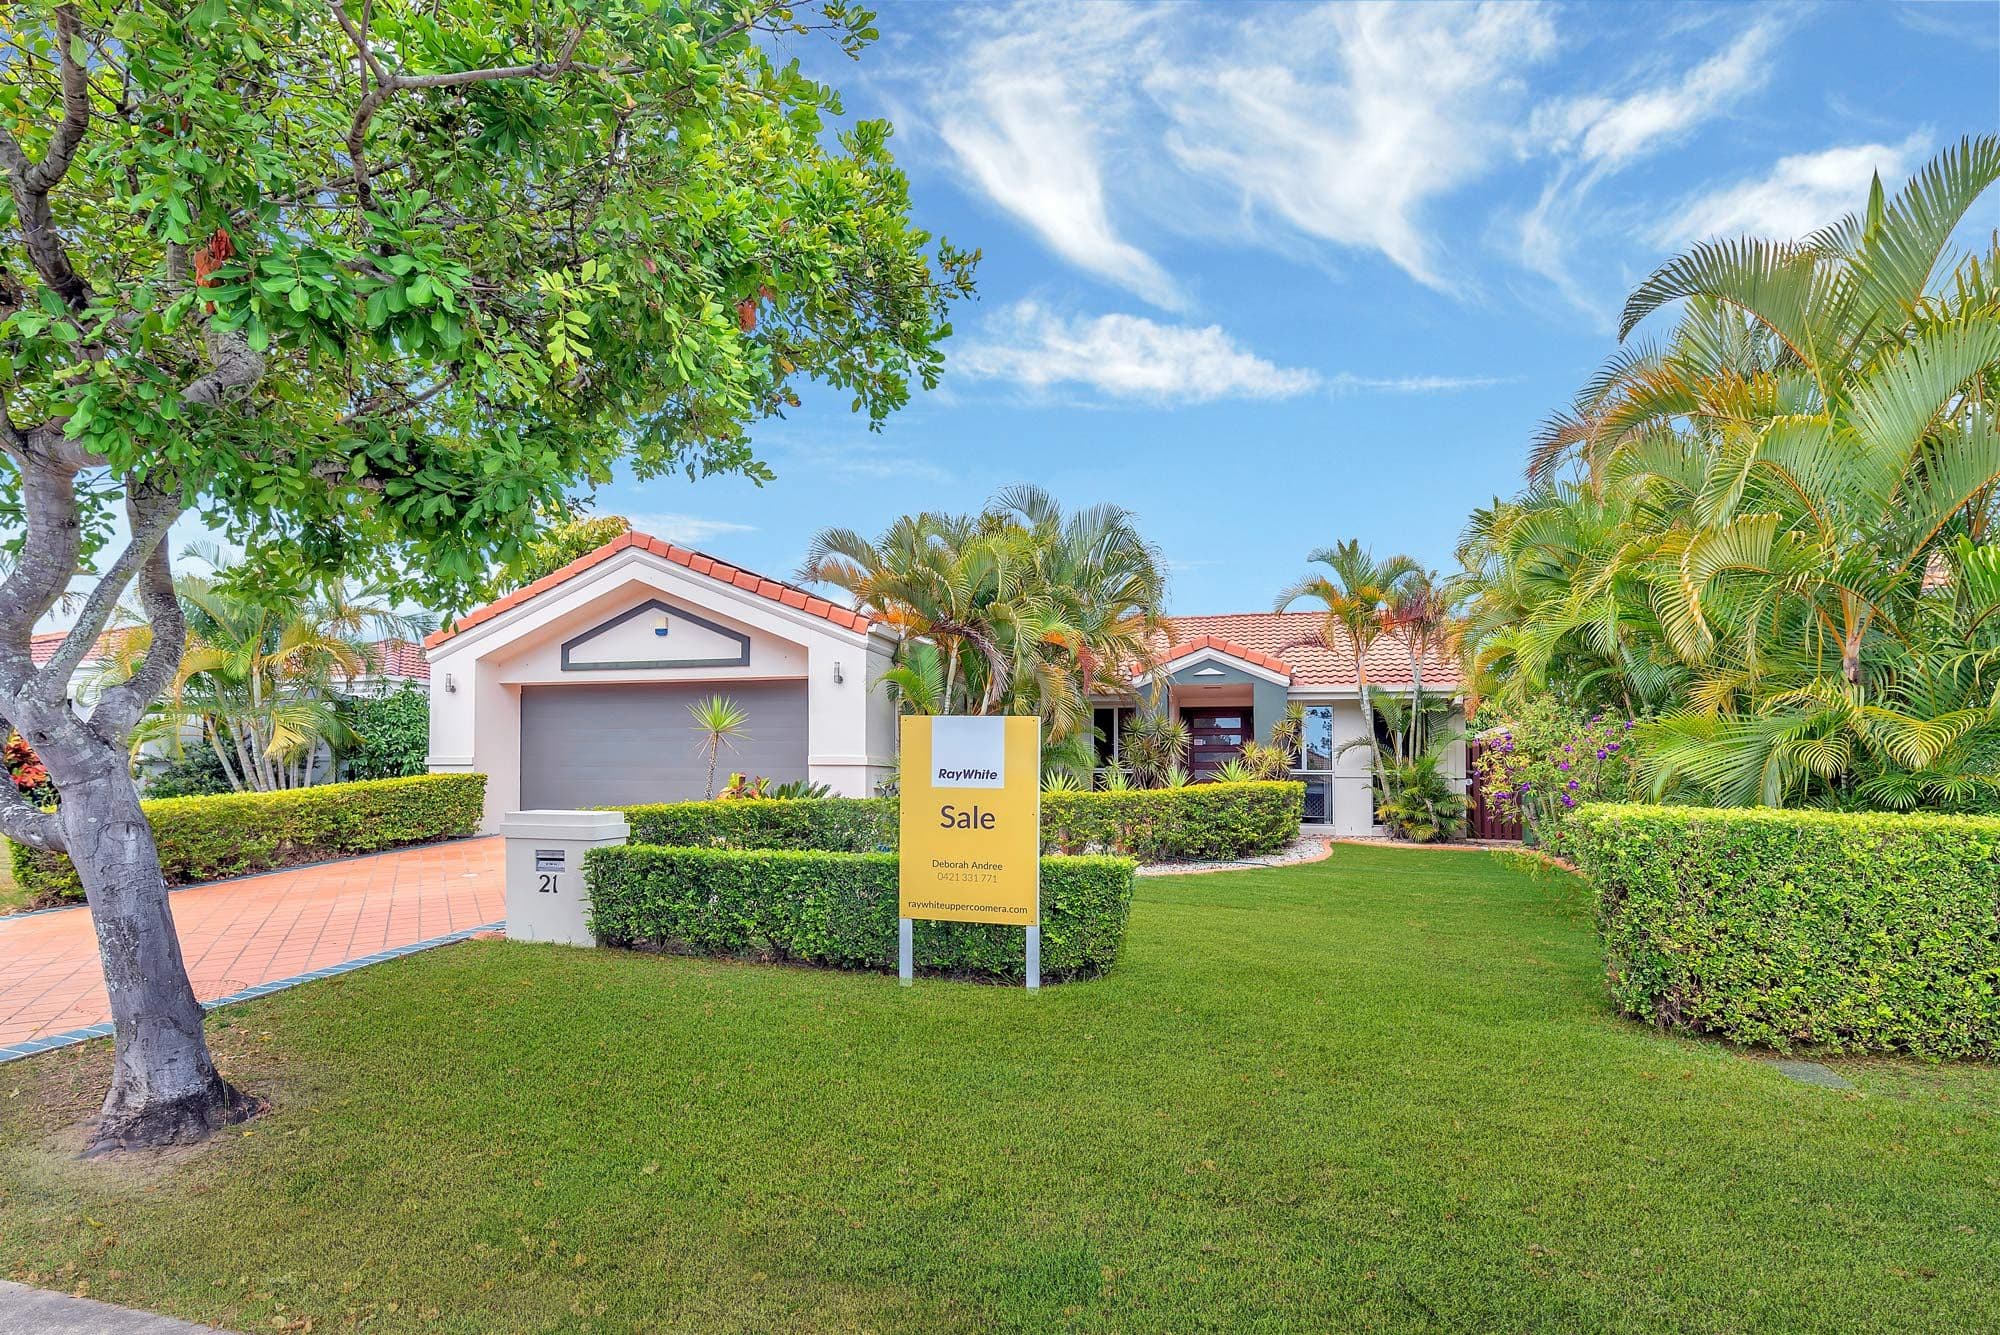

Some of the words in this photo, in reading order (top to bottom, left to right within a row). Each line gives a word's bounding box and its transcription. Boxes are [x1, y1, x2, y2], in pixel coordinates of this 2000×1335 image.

[940, 805, 996, 830] Sale
[932, 859, 969, 869] Deborah
[971, 861, 1003, 871] Andree
[539, 874, 558, 893] 21
[937, 872, 959, 882] 0421
[961, 873, 978, 883] 331
[981, 873, 998, 884] 771
[908, 901, 1028, 914] raywhiteuppercoomera.com
